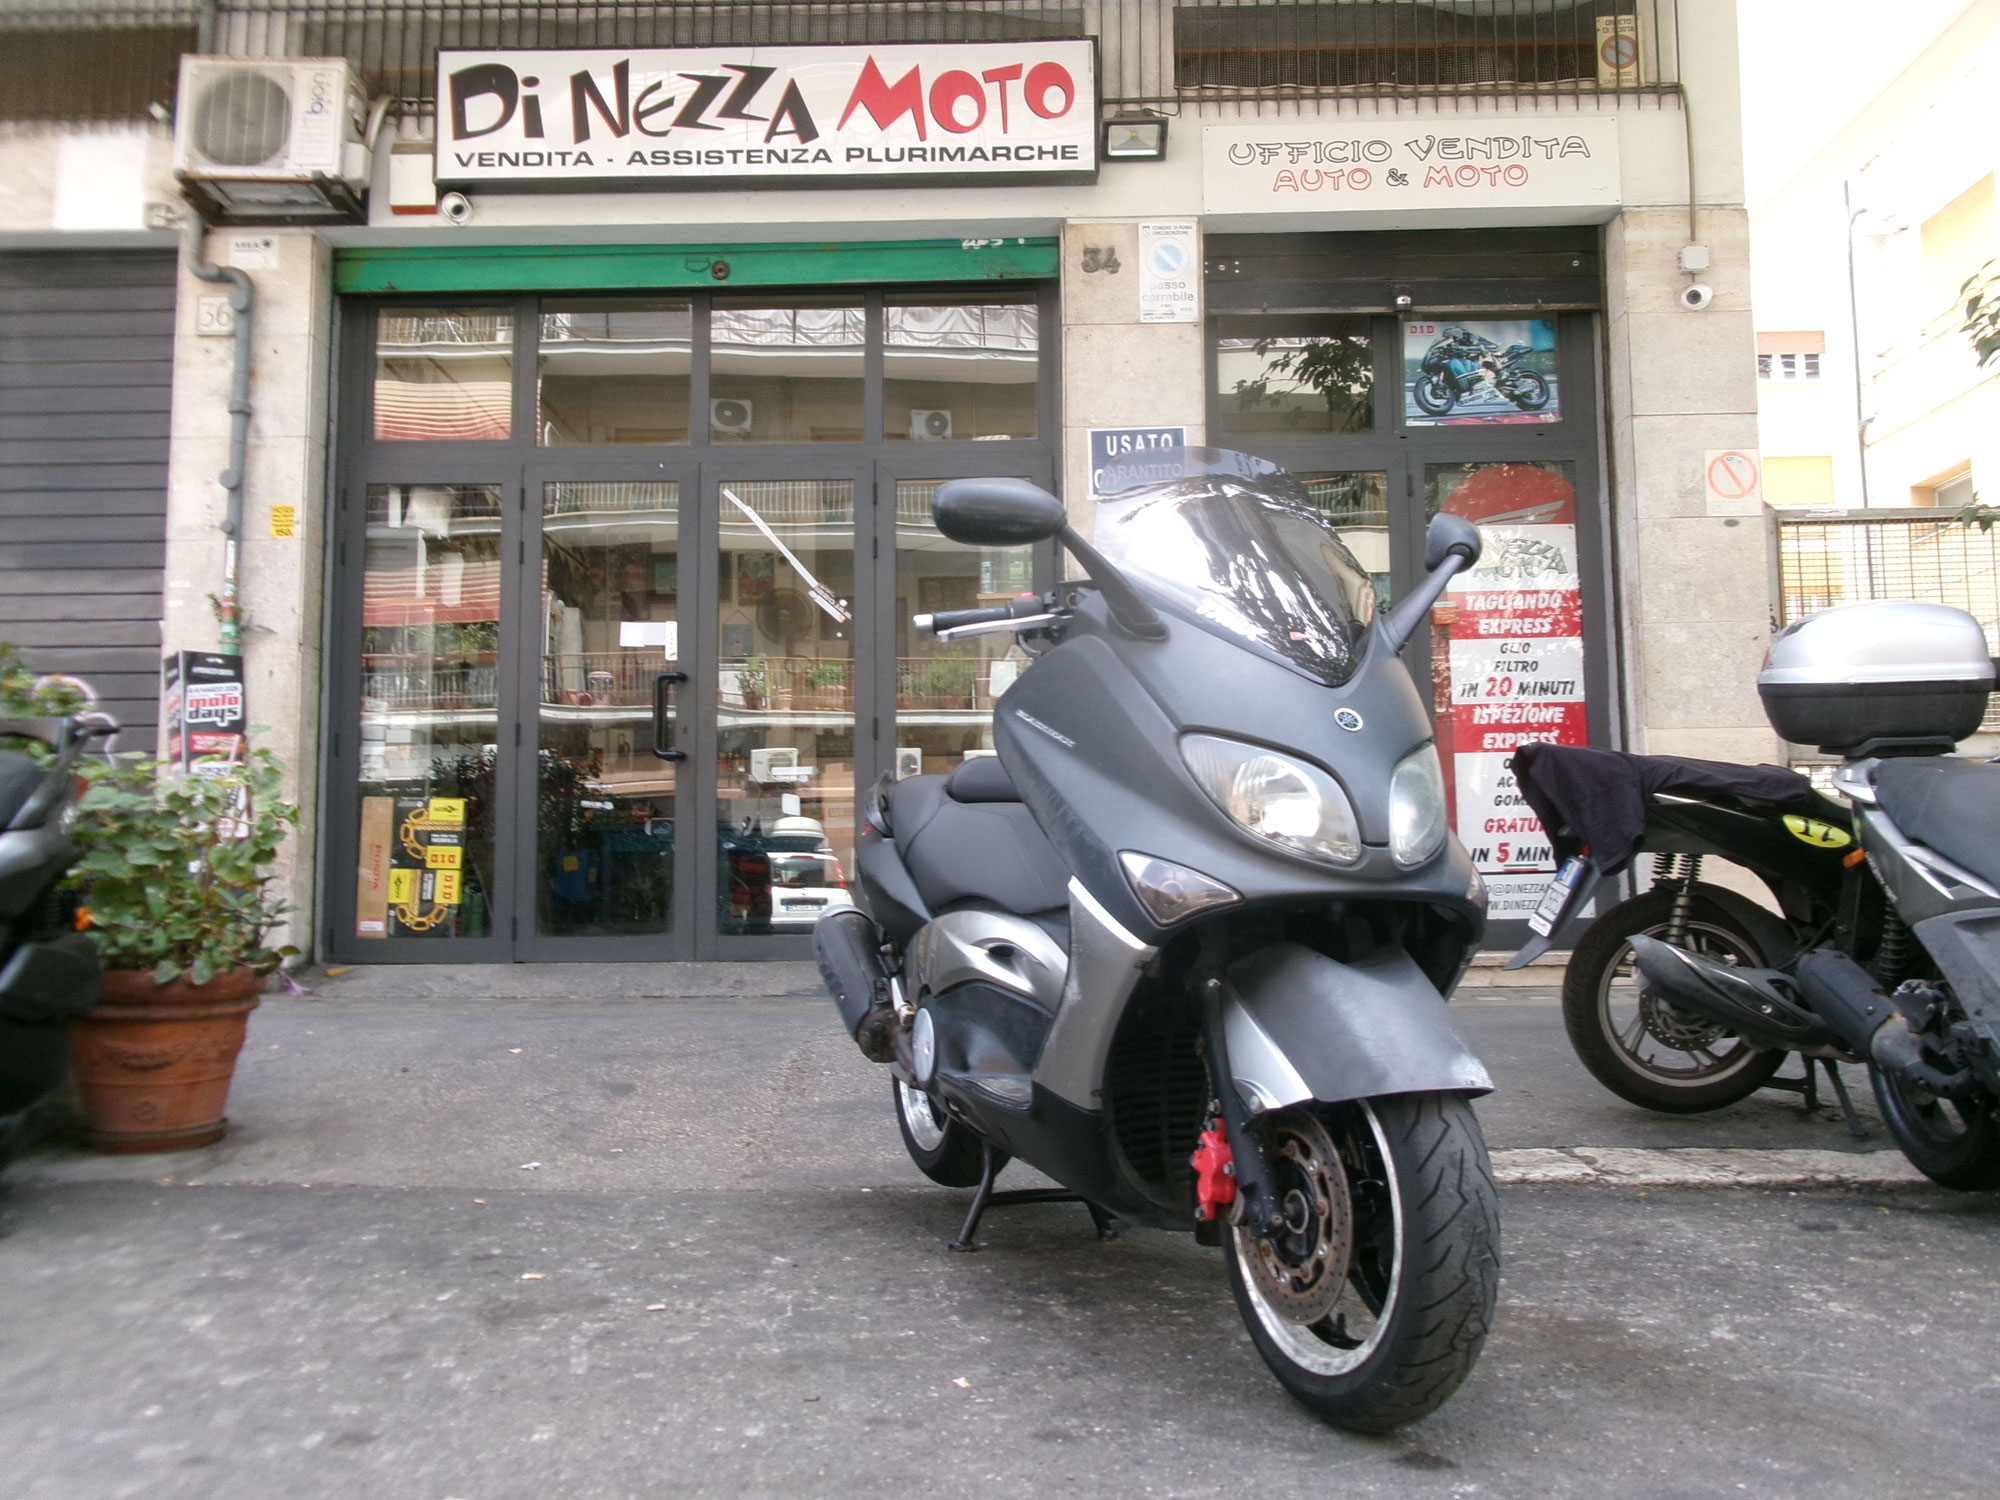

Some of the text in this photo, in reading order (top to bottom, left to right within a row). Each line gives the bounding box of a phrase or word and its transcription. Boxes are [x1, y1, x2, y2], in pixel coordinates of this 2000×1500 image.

[836, 54, 1075, 142] MOTO
[454, 151, 594, 167] VENDITA
[626, 147, 832, 166] ASSISTENZA
[846, 144, 1079, 163] PLURIMARCHE
[1228, 135, 1591, 165] UFFICIO VENDITA
[1273, 164, 1529, 192] AUTO & MOTO
[199, 302, 231, 327] 36
[1410, 325, 1435, 334] DID
[1106, 433, 1173, 456] USATO
[1465, 593, 1563, 610] TAGLIANDO
[1478, 617, 1553, 635] EXPRESS
[1493, 660, 1539, 673] FILTRO
[1485, 676, 1513, 697] 20
[1517, 681, 1576, 697] MINUTI
[188, 693, 239, 708] moto
[188, 706, 239, 724] days
[1472, 706, 1566, 725] ISPEZIONE
[1796, 818, 1836, 842] 17
[430, 853, 457, 864] DID
[1472, 842, 1553, 864] IN 5 MIN
[443, 873, 454, 900] DID
